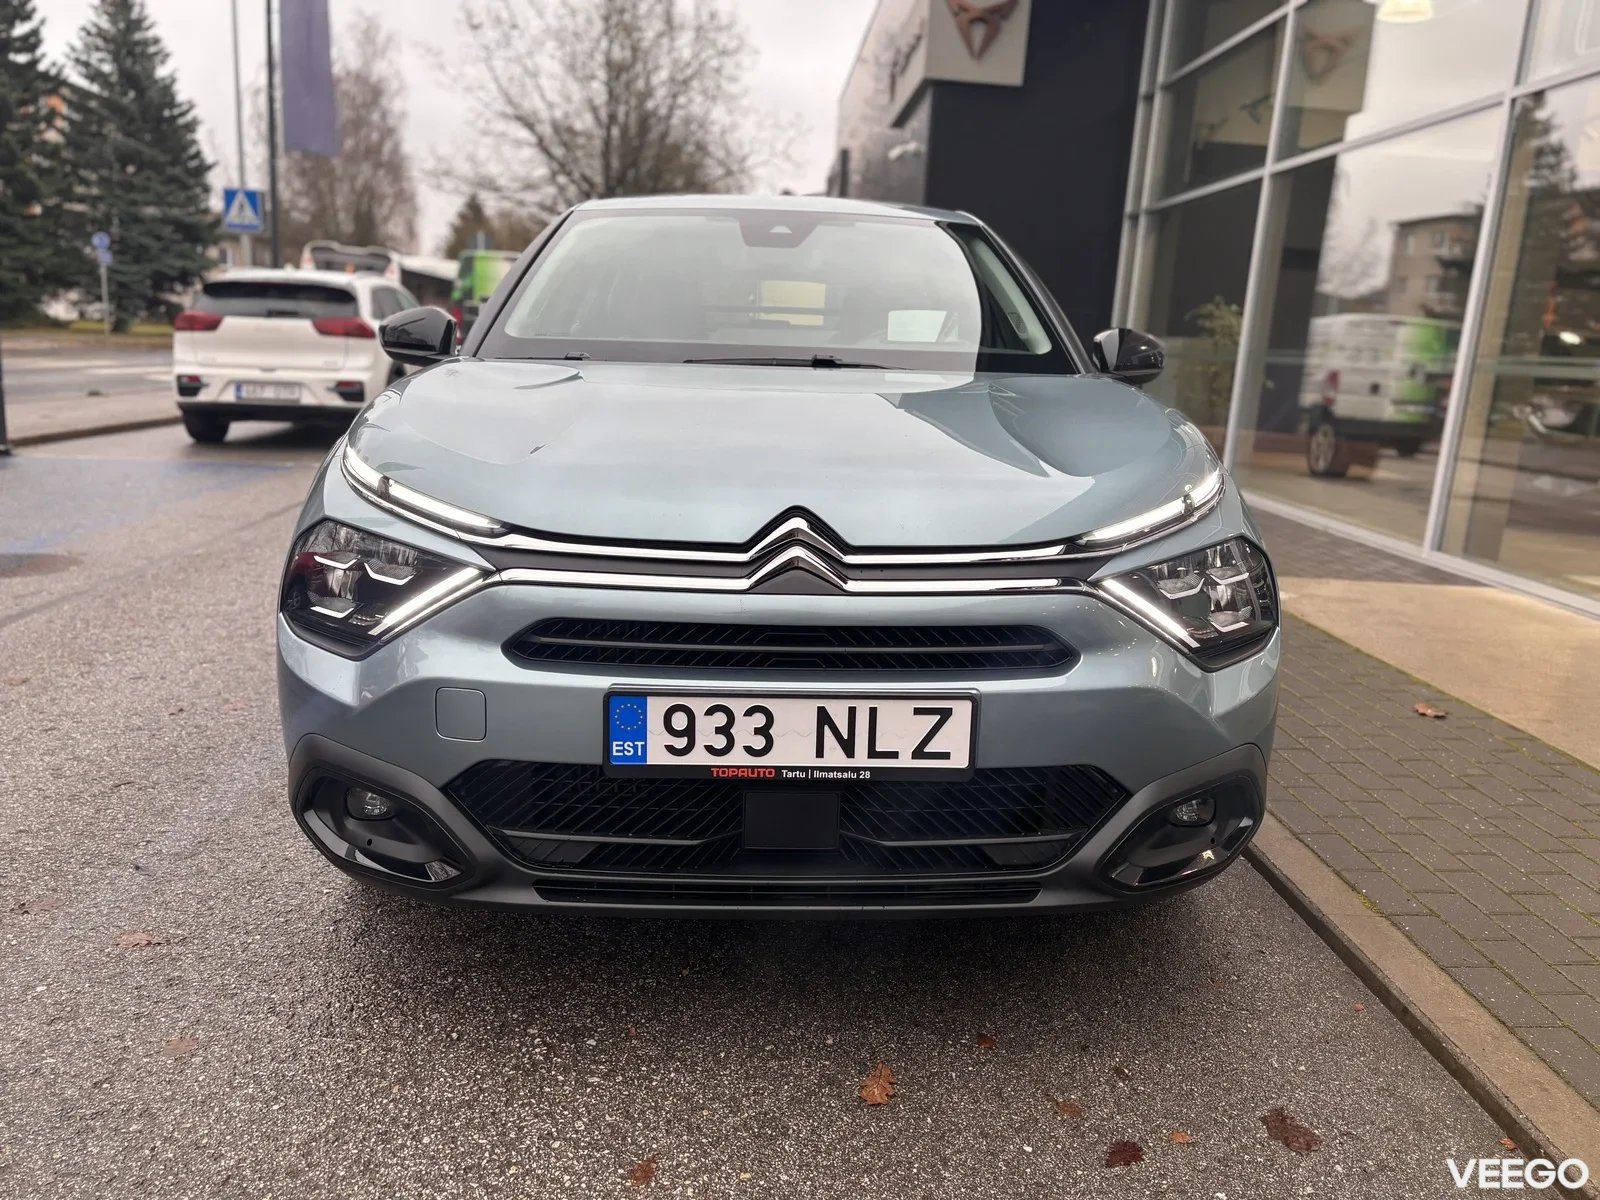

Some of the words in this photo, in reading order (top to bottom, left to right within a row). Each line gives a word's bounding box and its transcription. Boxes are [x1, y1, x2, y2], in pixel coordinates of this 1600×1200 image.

[662, 703, 776, 758] 933
[815, 704, 954, 761] NLZ
[612, 741, 645, 756] EST
[711, 767, 775, 778] TOPAUTO
[781, 769, 806, 778] Tartu
[813, 770, 857, 779] Ilmatsalu
[859, 771, 871, 779] 28
